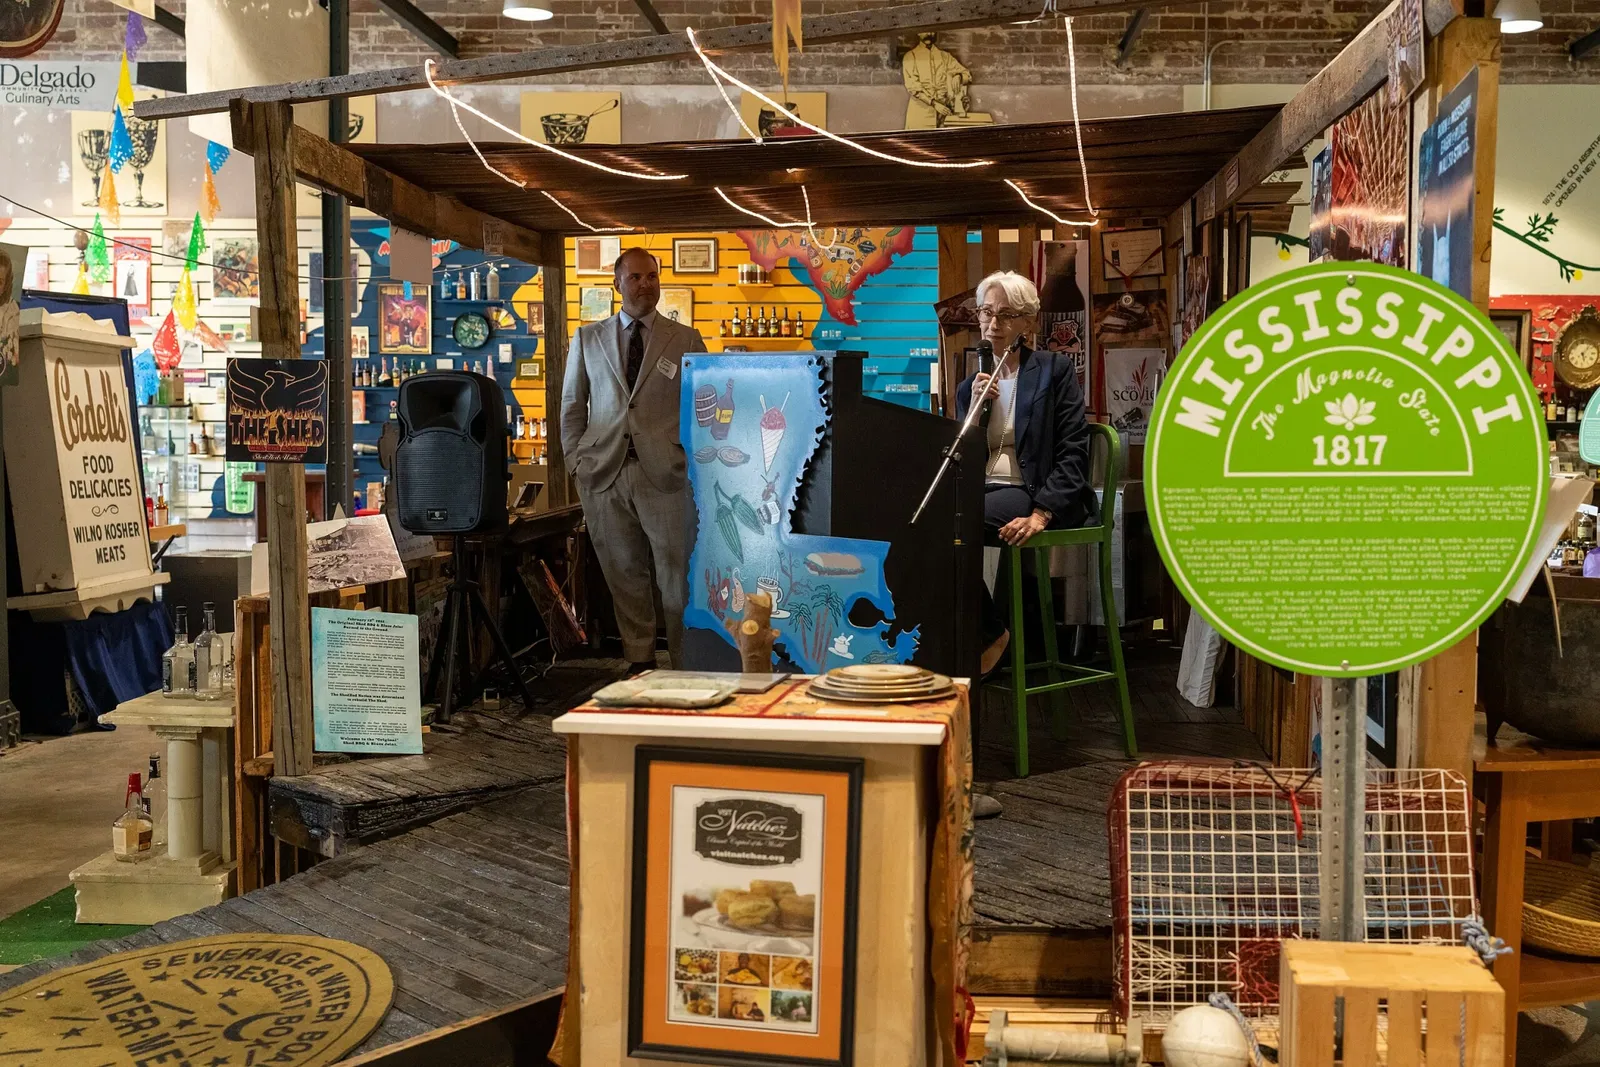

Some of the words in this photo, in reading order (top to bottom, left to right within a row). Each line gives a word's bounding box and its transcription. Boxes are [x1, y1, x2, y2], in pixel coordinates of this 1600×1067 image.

[0, 64, 96, 94] Delgado
[5, 92, 53, 106] Culinary
[56, 94, 80, 105] Arts
[1555, 176, 1568, 190] THE
[1566, 163, 1580, 178] OLD
[1555, 182, 1578, 207] OPENED
[1575, 174, 1584, 183] IN
[1582, 158, 1597, 175] NEW
[1174, 286, 1523, 438] MISSISSIPPI
[54, 357, 127, 451] Cordell's
[1251, 404, 1284, 440] The
[1292, 366, 1395, 405] Magnolia
[1398, 387, 1440, 437] State
[83, 455, 114, 474] FOOD
[1312, 435, 1388, 466] 1817
[69, 478, 132, 499] DELICACIES
[73, 524, 102, 544] WILNO
[104, 521, 140, 541] KOSHER
[96, 544, 126, 565] MEATS
[699, 809, 800, 841] Natchez
[710, 849, 785, 863] visitnatchez.org
[141, 947, 320, 972] SEWERAGE
[306, 963, 335, 977] &
[193, 964, 313, 1012] CRESCENT
[310, 972, 351, 1025] WATER
[244, 1014, 306, 1049] BOX
